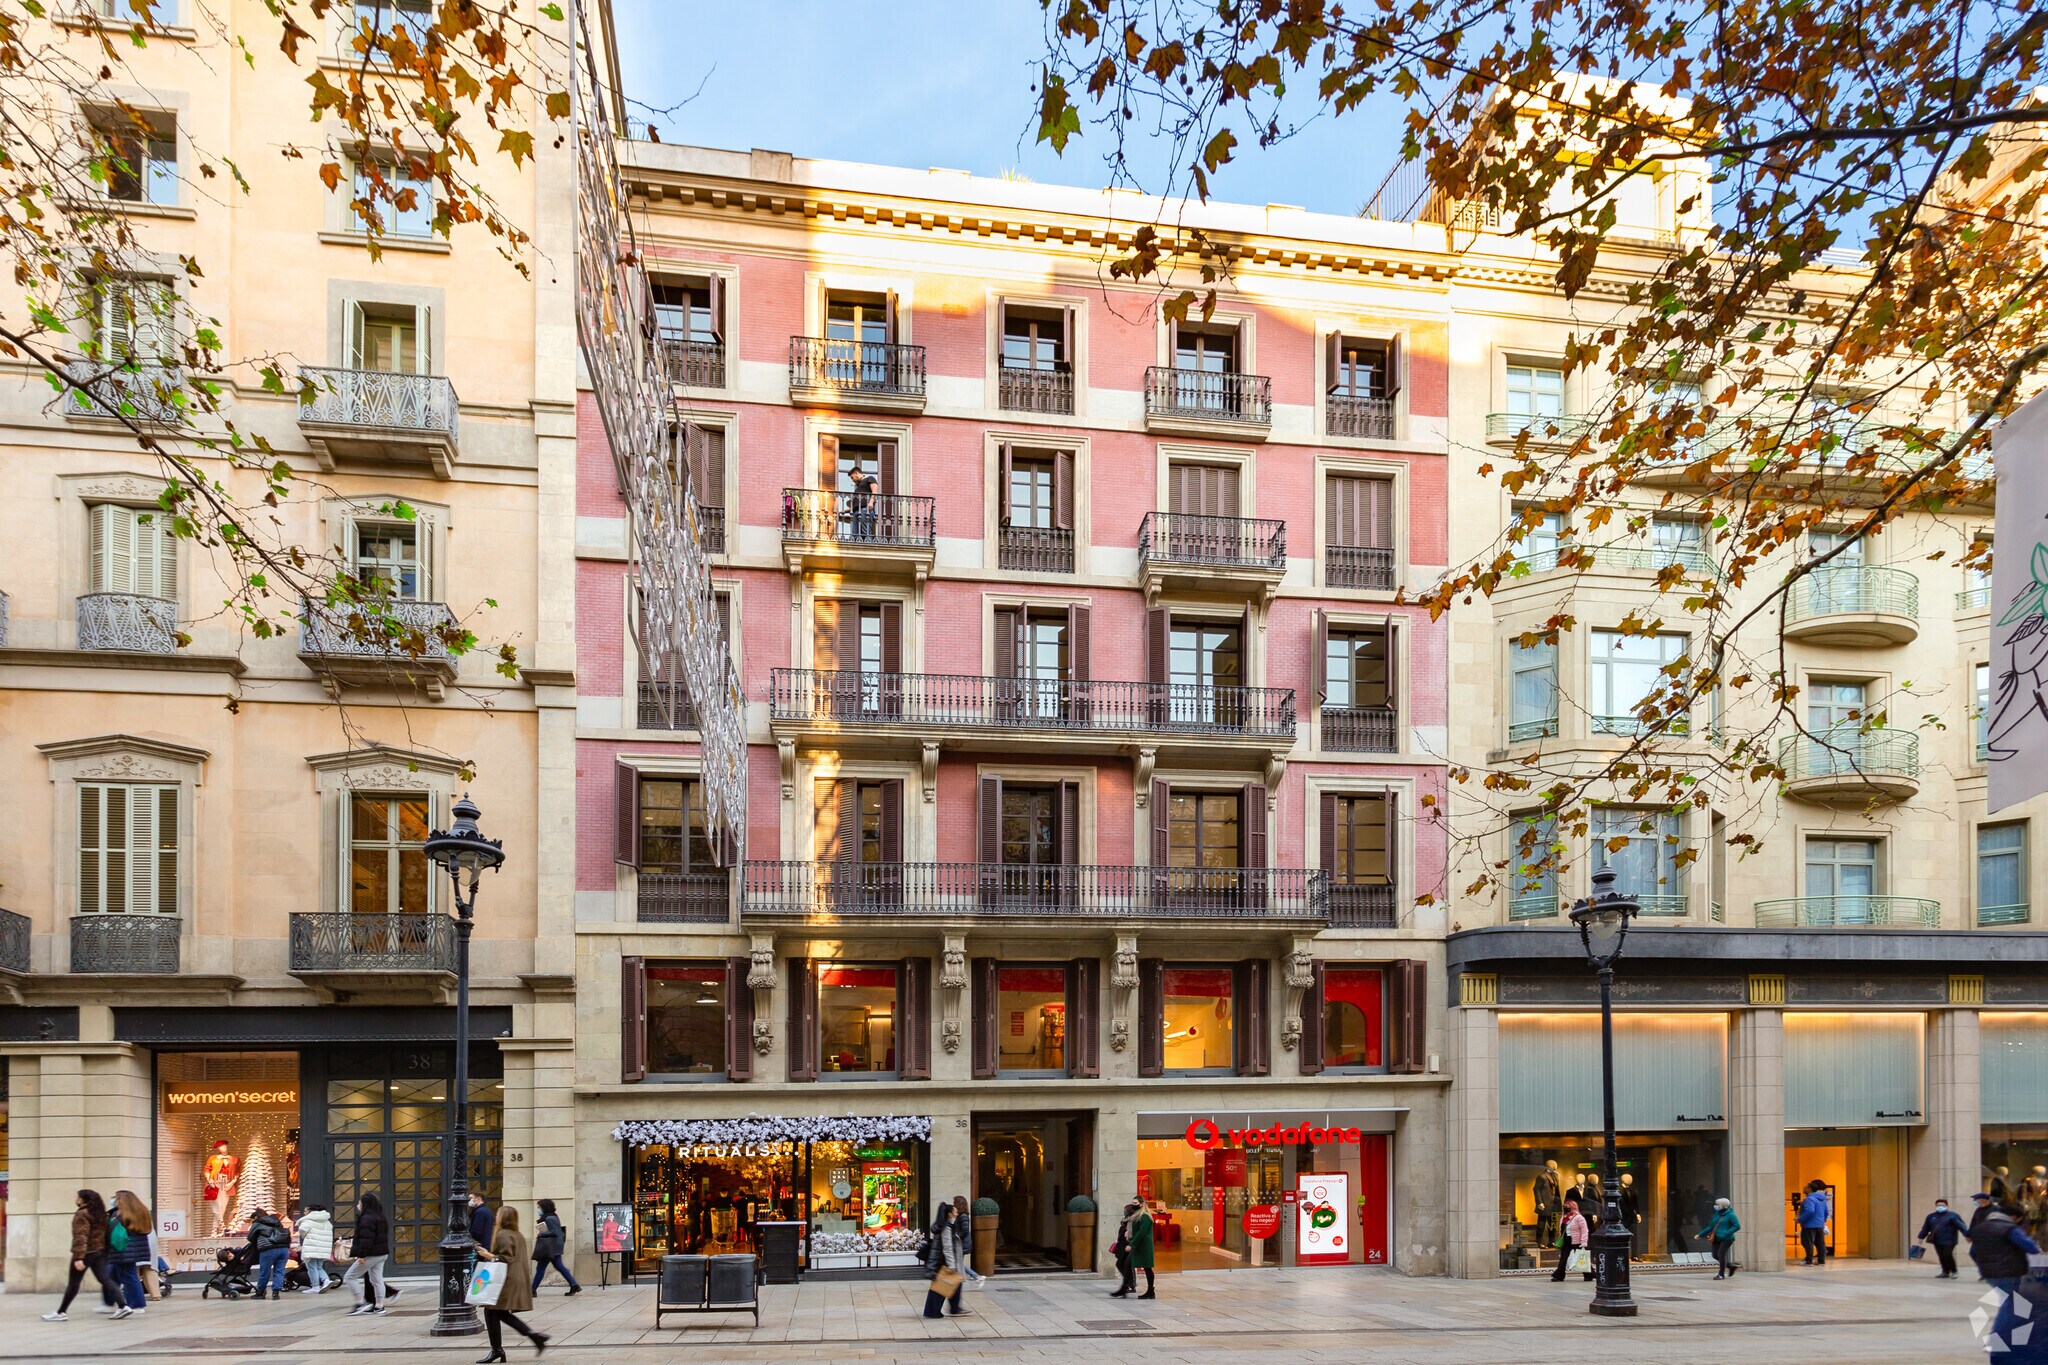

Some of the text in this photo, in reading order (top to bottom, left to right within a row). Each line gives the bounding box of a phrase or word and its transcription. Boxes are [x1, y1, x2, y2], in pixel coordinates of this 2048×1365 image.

[408, 1053, 431, 1070] 38
[168, 1090, 297, 1104] women'secret
[955, 1119, 968, 1128] 36
[1227, 1121, 1361, 1145] vodafone
[510, 1153, 524, 1162] 38
[163, 1221, 179, 1232] 50
[1368, 1249, 1382, 1259] 24
